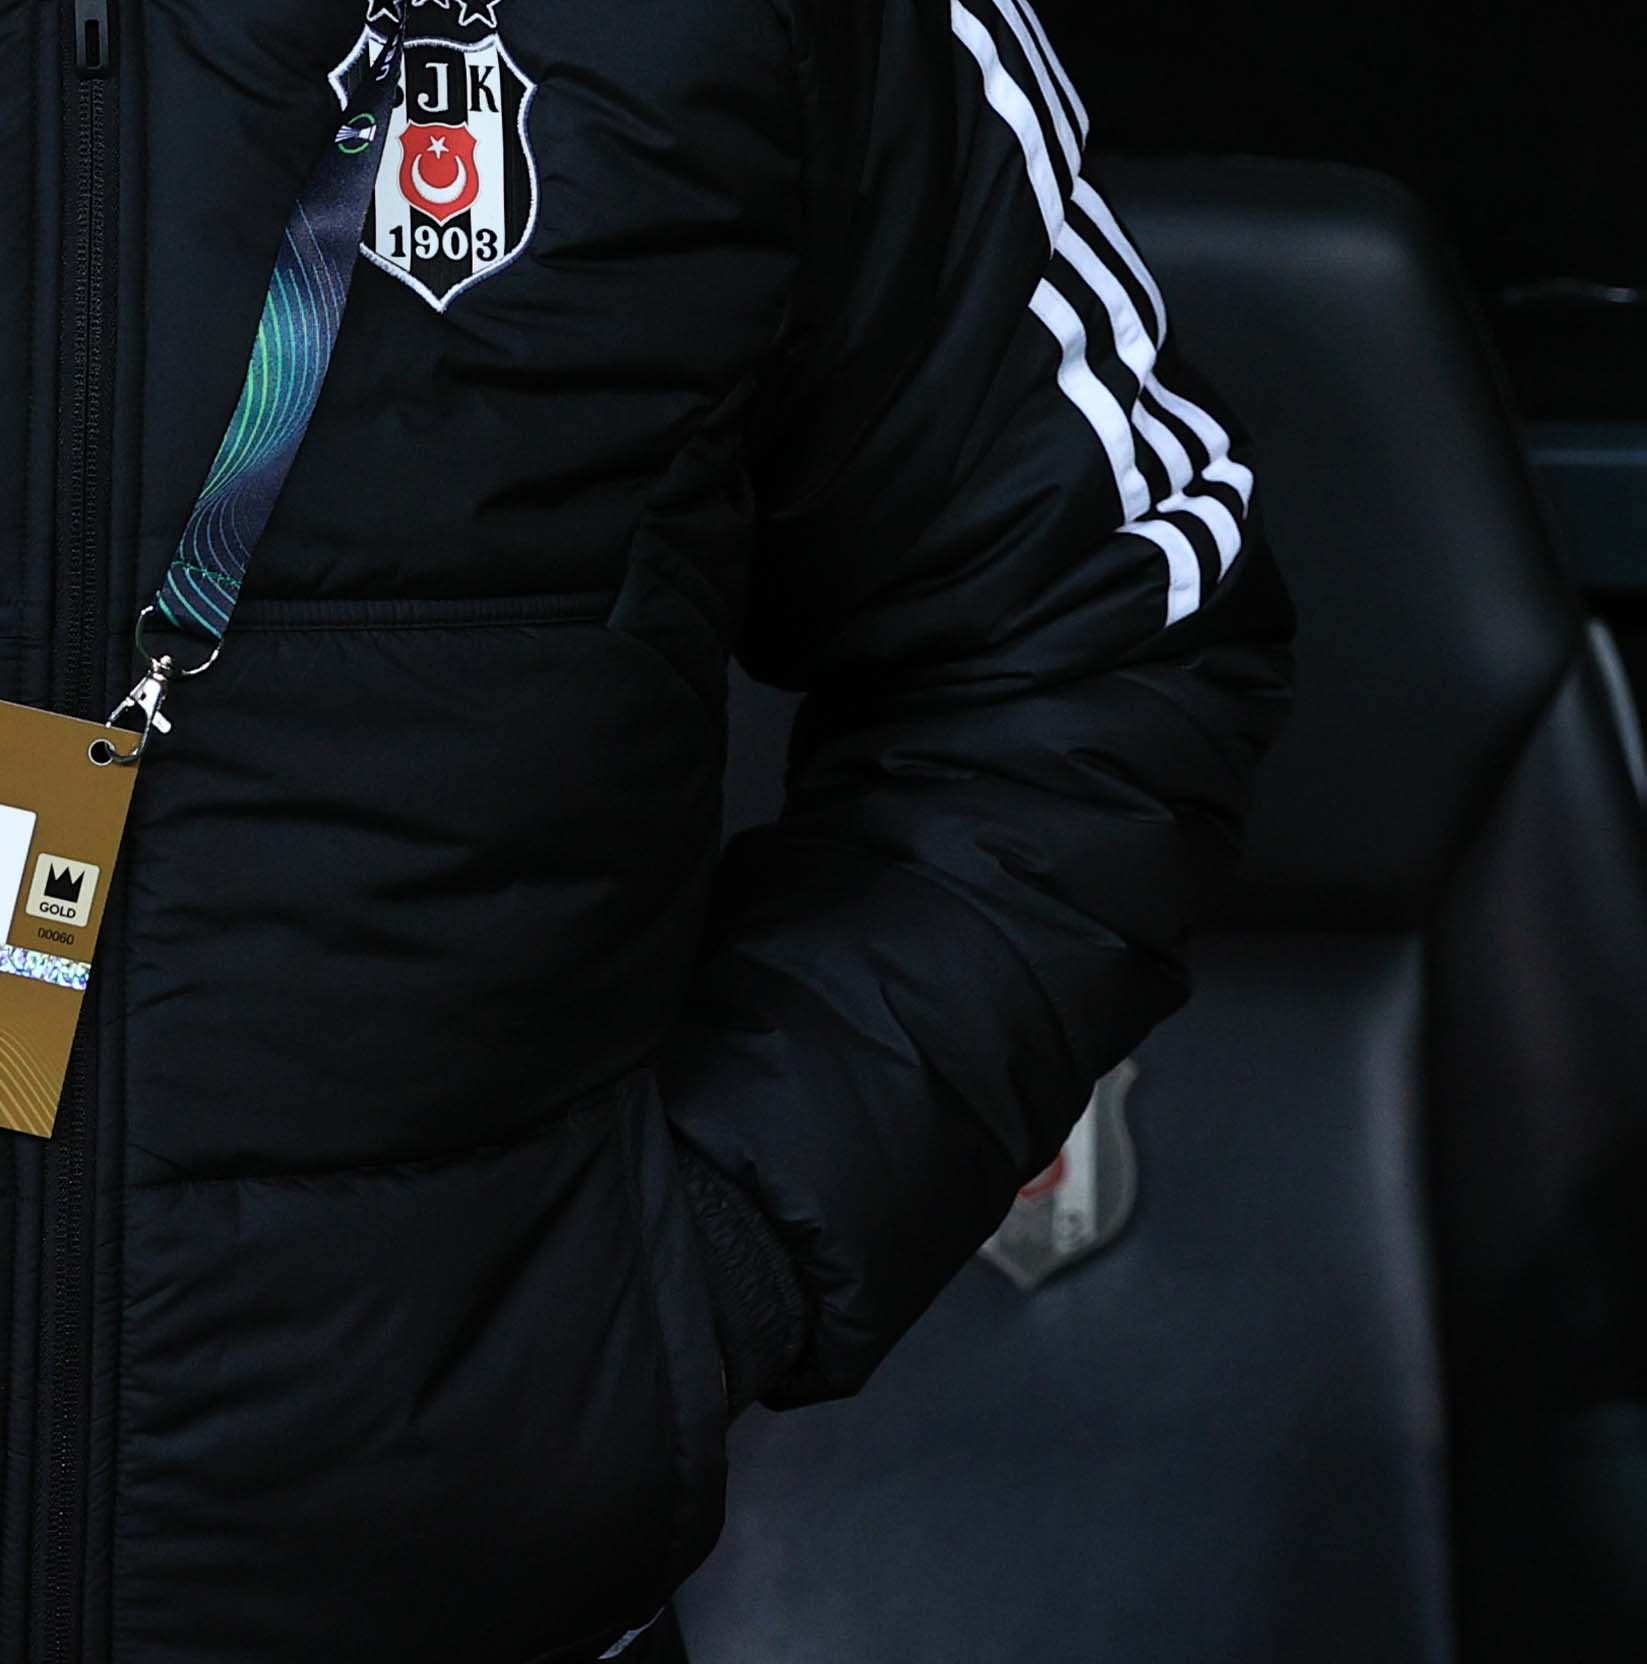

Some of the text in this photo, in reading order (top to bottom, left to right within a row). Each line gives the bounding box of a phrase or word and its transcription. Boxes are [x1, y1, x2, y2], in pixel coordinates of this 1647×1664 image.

[392, 62, 501, 113] JK
[389, 225, 499, 262] 1903
[39, 902, 76, 919] GOLD
[37, 927, 75, 945] 00060
